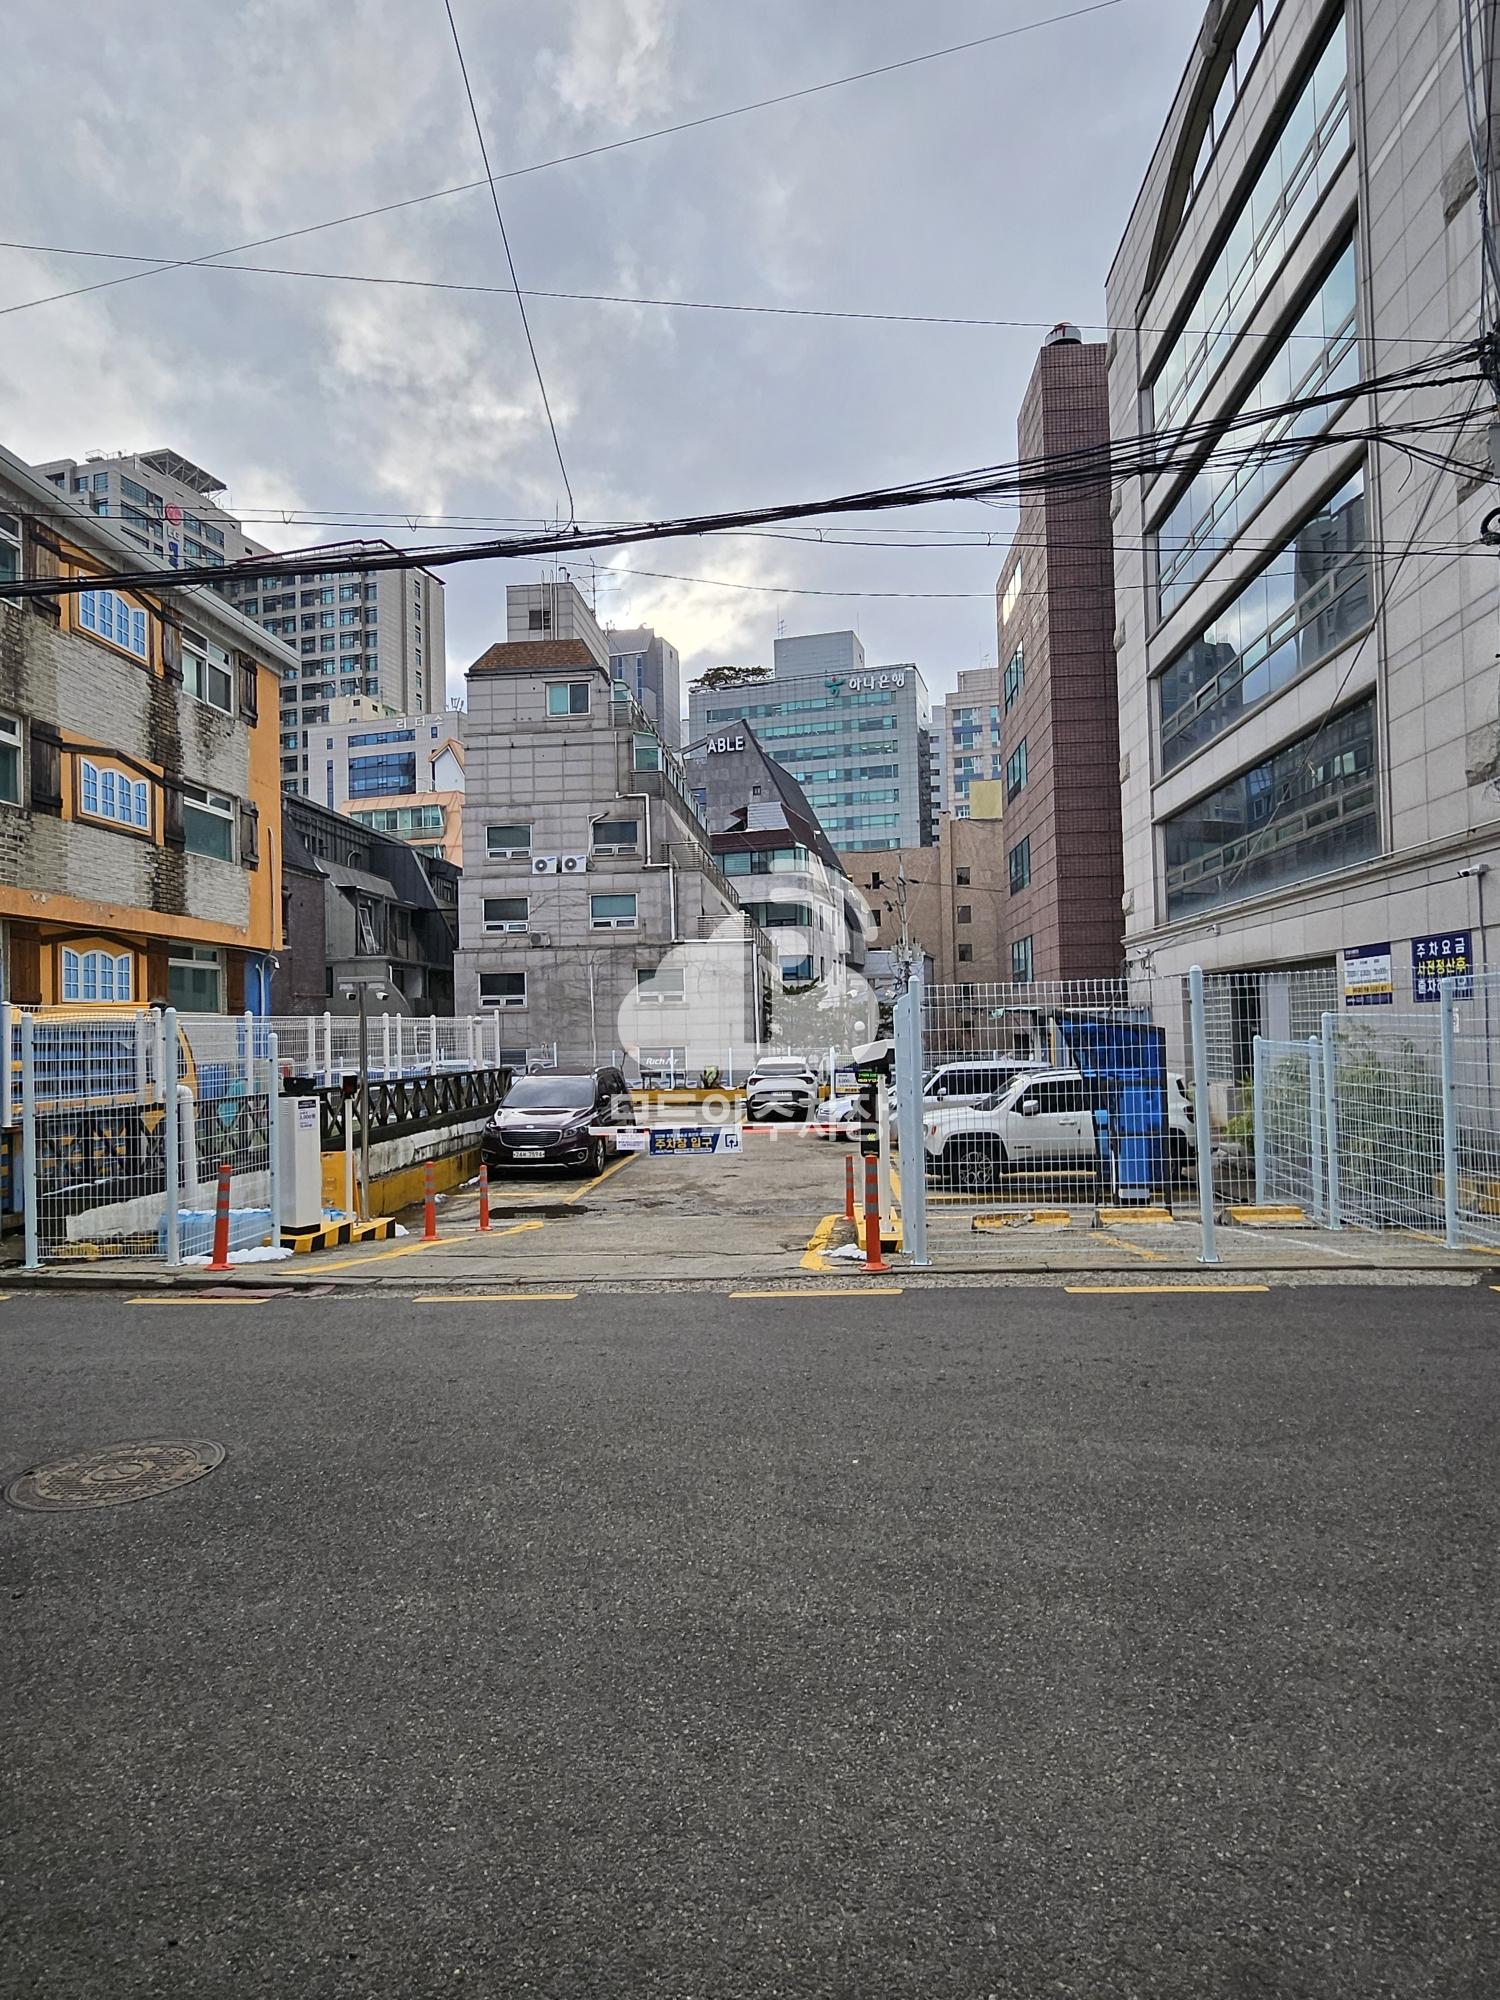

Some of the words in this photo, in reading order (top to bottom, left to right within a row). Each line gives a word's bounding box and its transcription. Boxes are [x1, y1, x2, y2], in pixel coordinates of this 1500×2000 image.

[849, 673, 905, 691] 하나은행
[396, 715, 444, 729] 리더스
[707, 735, 744, 753] ABLE
[1416, 937, 1465, 958] 주차요금
[655, 1137, 688, 1150] 주차장
[691, 1136, 713, 1149] 입구
